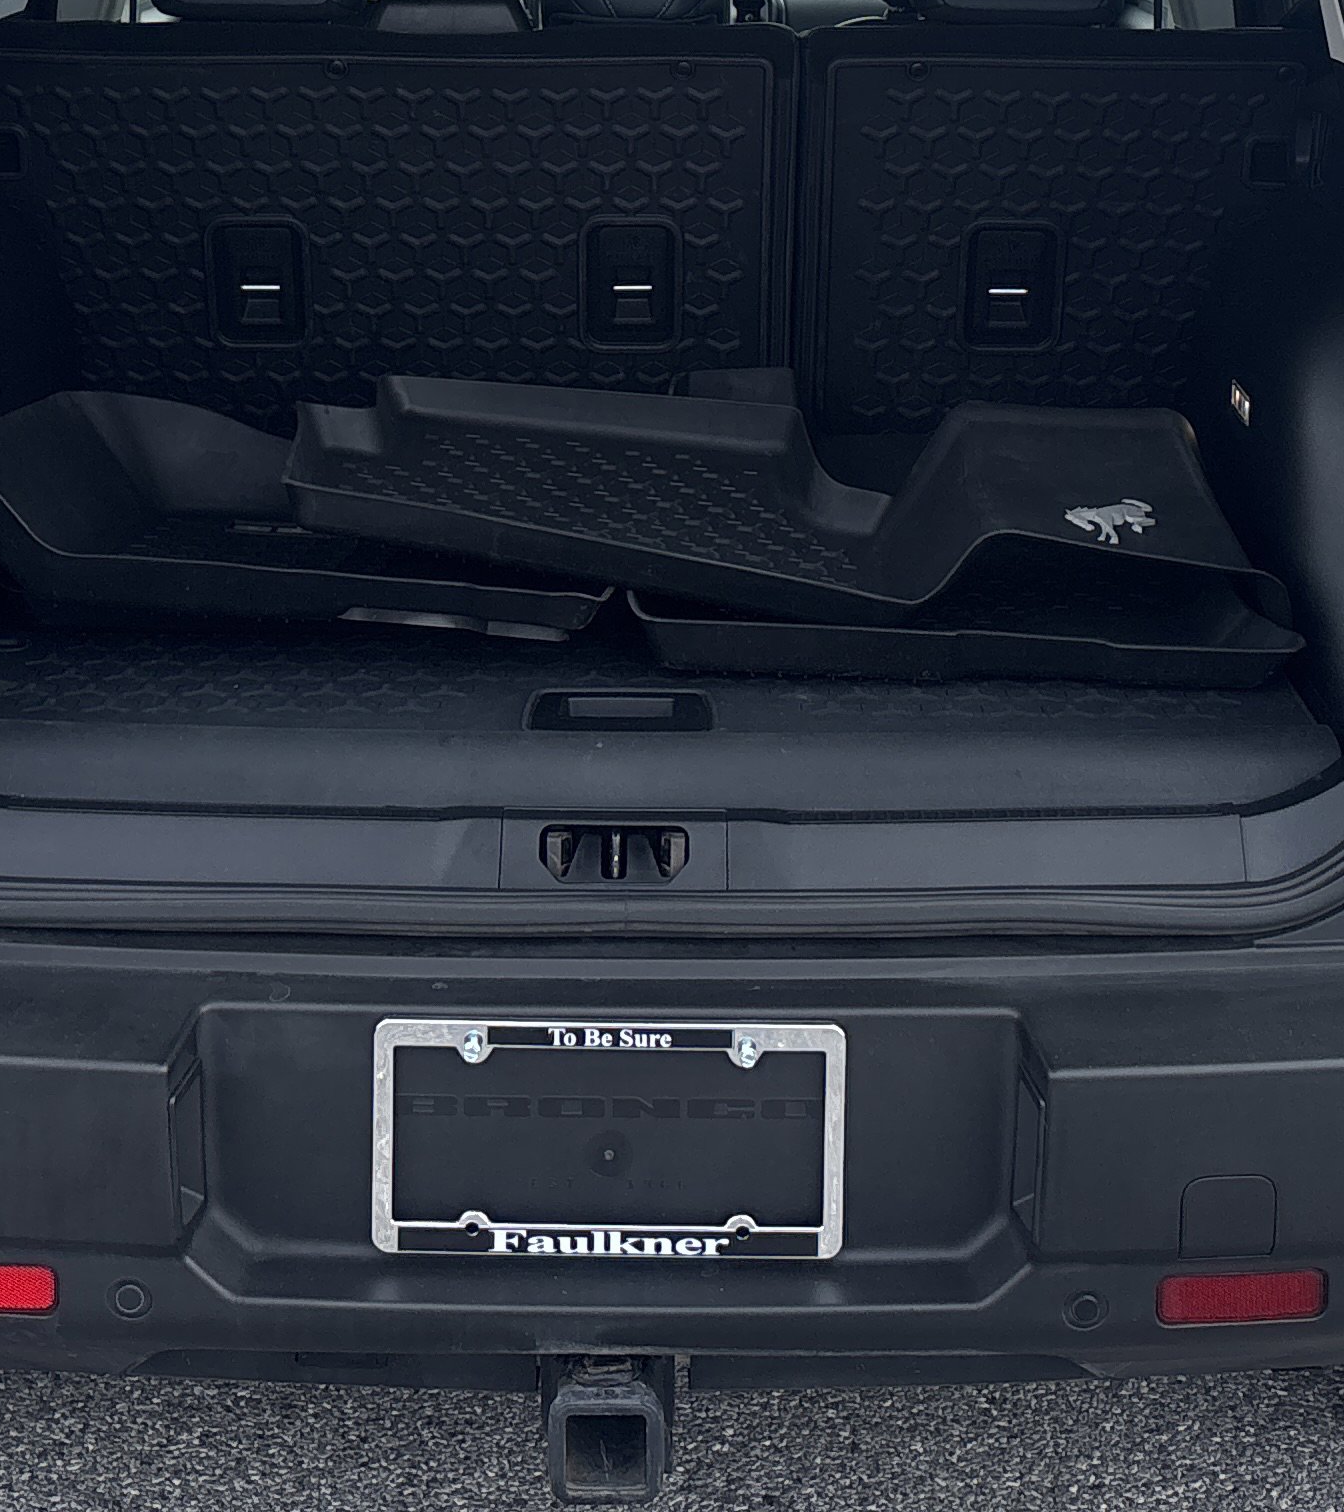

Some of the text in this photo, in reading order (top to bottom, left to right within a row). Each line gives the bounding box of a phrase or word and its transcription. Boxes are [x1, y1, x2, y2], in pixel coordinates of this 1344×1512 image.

[547, 1027, 673, 1048] To Be Sure
[395, 1093, 823, 1120] BRONCO
[487, 1229, 730, 1256] Faulkner
